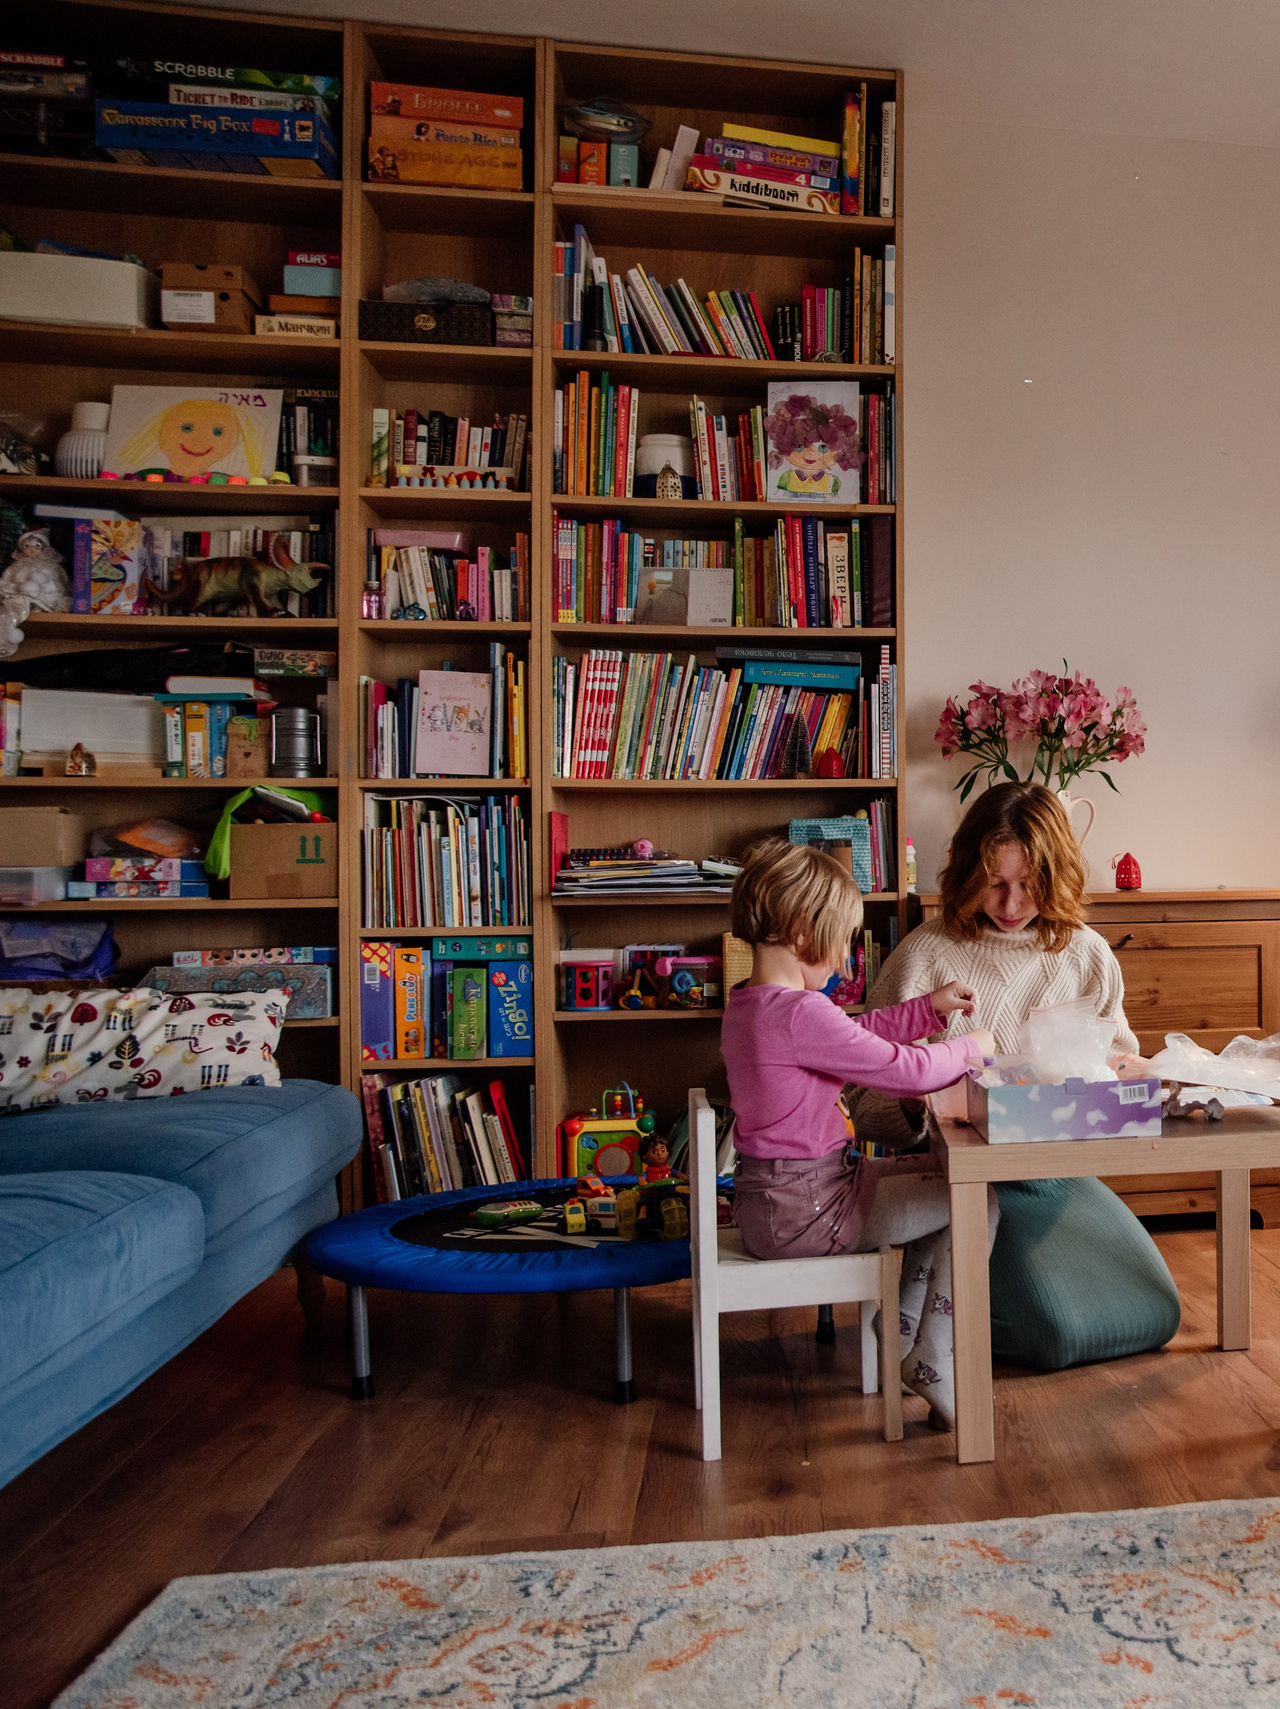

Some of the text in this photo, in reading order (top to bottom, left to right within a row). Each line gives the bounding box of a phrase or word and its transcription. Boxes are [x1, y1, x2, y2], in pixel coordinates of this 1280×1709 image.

[0, 53, 66, 67] SCRABBLE
[154, 60, 236, 79] SCRABBLE
[175, 88, 217, 105] TICKET
[230, 92, 257, 108] RIDE
[189, 113, 218, 134] Big
[219, 116, 251, 132] Box
[729, 178, 799, 203] kiddiboom
[219, 392, 267, 407] מאיה
[806, 523, 817, 618] МИФЫ ДРЕВНЕЙ ГРЕЦИИ
[498, 980, 531, 1040] Zingo!
